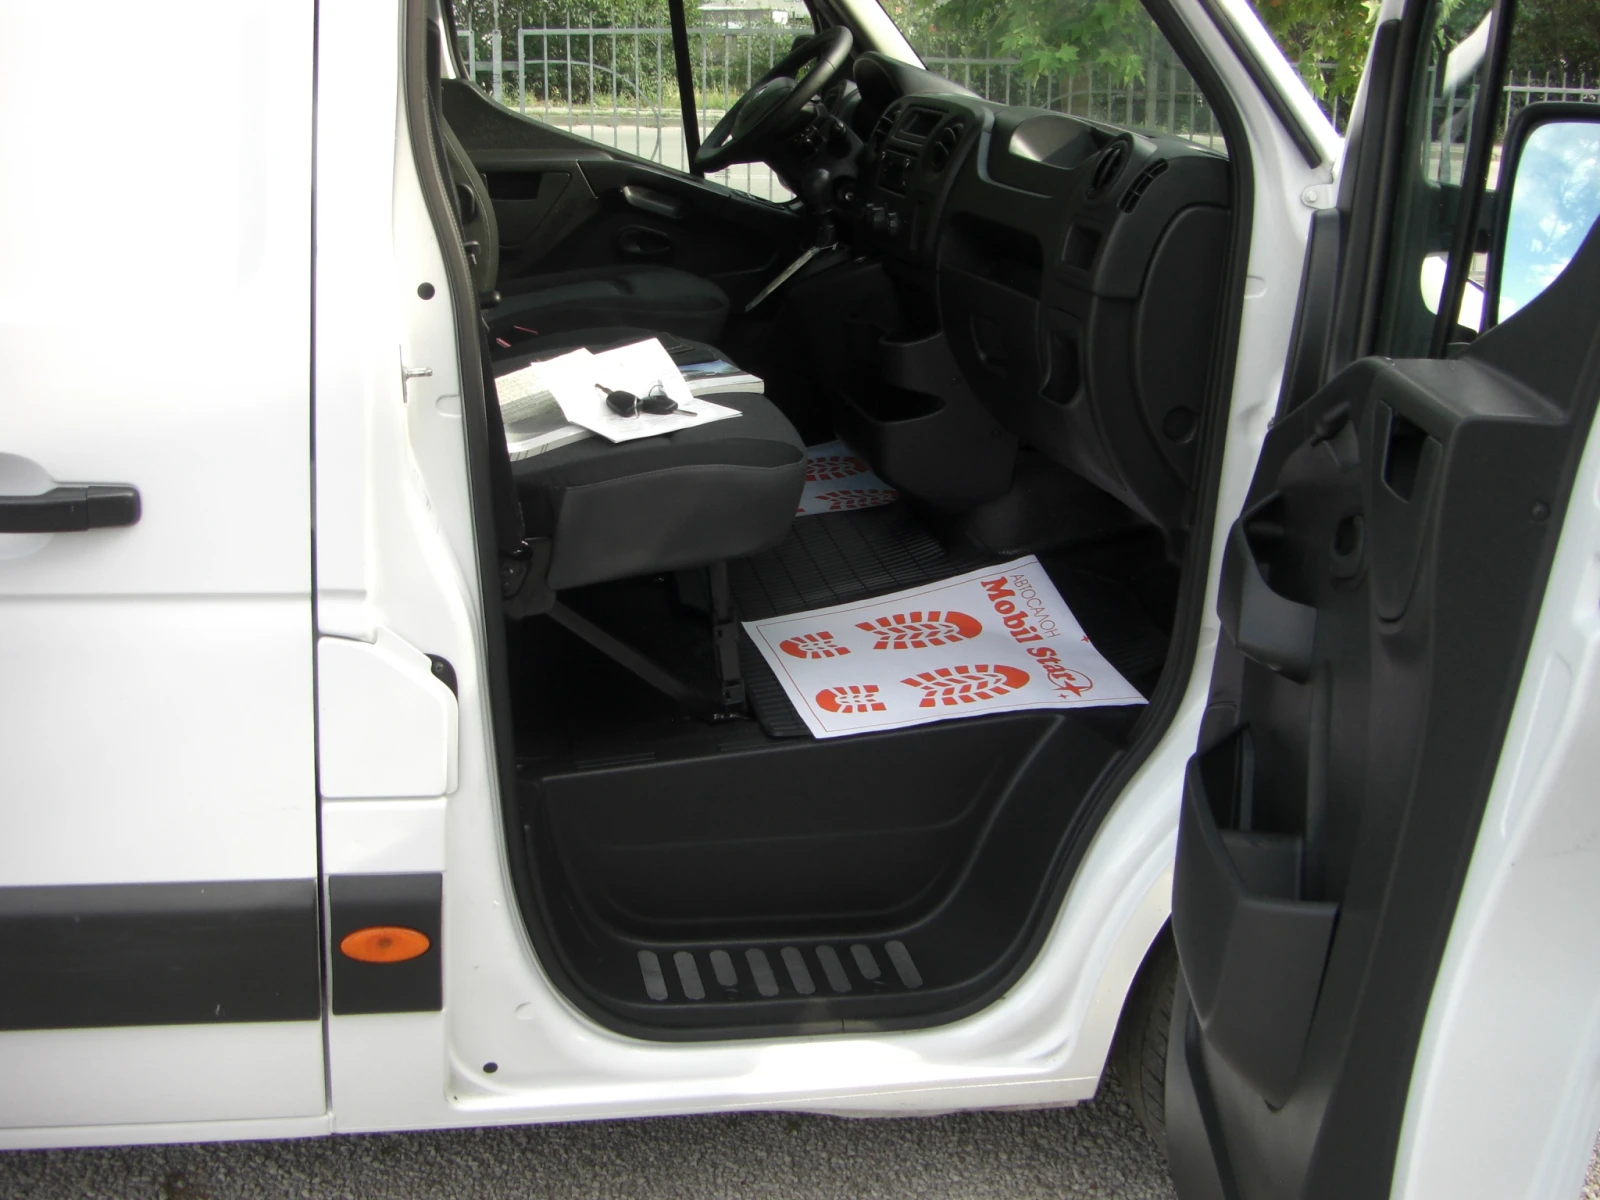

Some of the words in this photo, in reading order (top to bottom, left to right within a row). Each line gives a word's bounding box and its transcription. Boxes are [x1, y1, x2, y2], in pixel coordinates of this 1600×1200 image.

[981, 576, 1043, 643] Mobil
[1027, 647, 1076, 682] Star
[1011, 574, 1060, 638] АВТОСАЛОН
